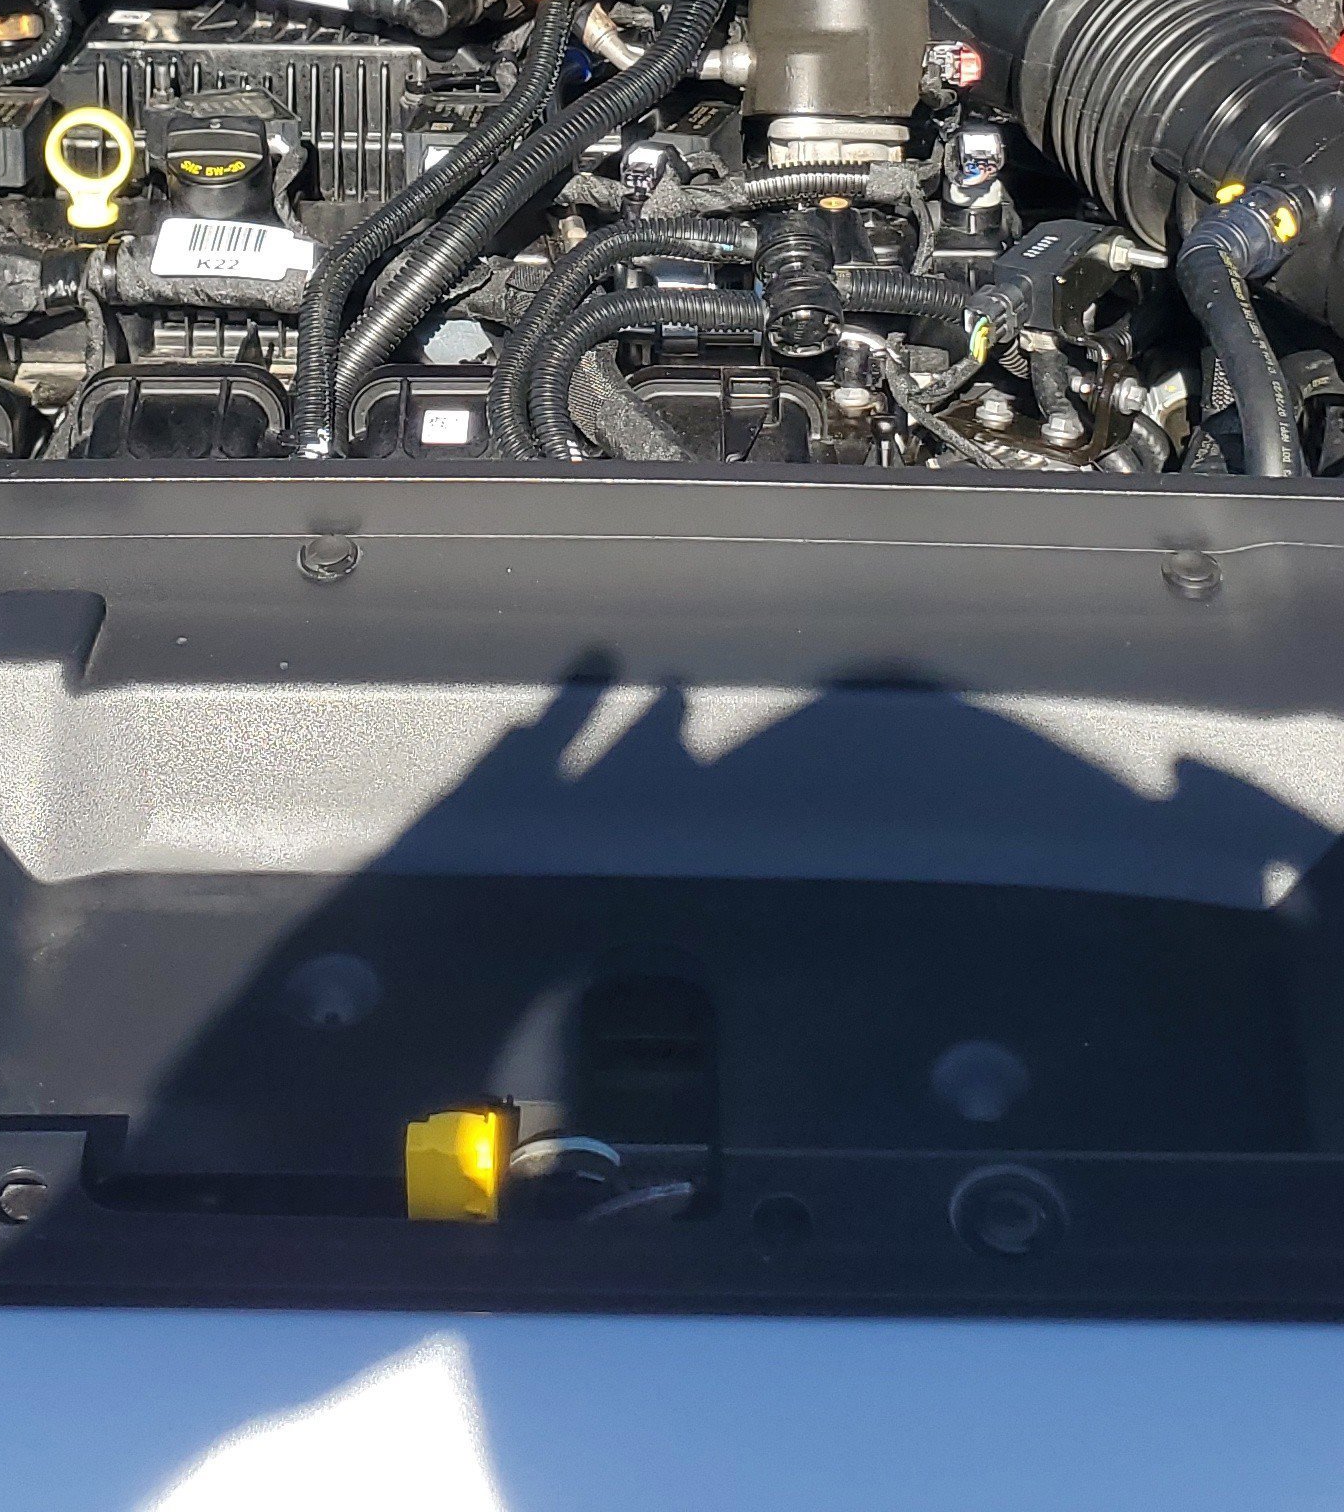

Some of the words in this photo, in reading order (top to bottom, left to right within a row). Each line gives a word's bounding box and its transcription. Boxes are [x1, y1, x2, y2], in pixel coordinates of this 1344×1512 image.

[180, 160, 203, 176] SAE
[205, 160, 246, 177] 5W-30
[195, 258, 241, 271] K22
